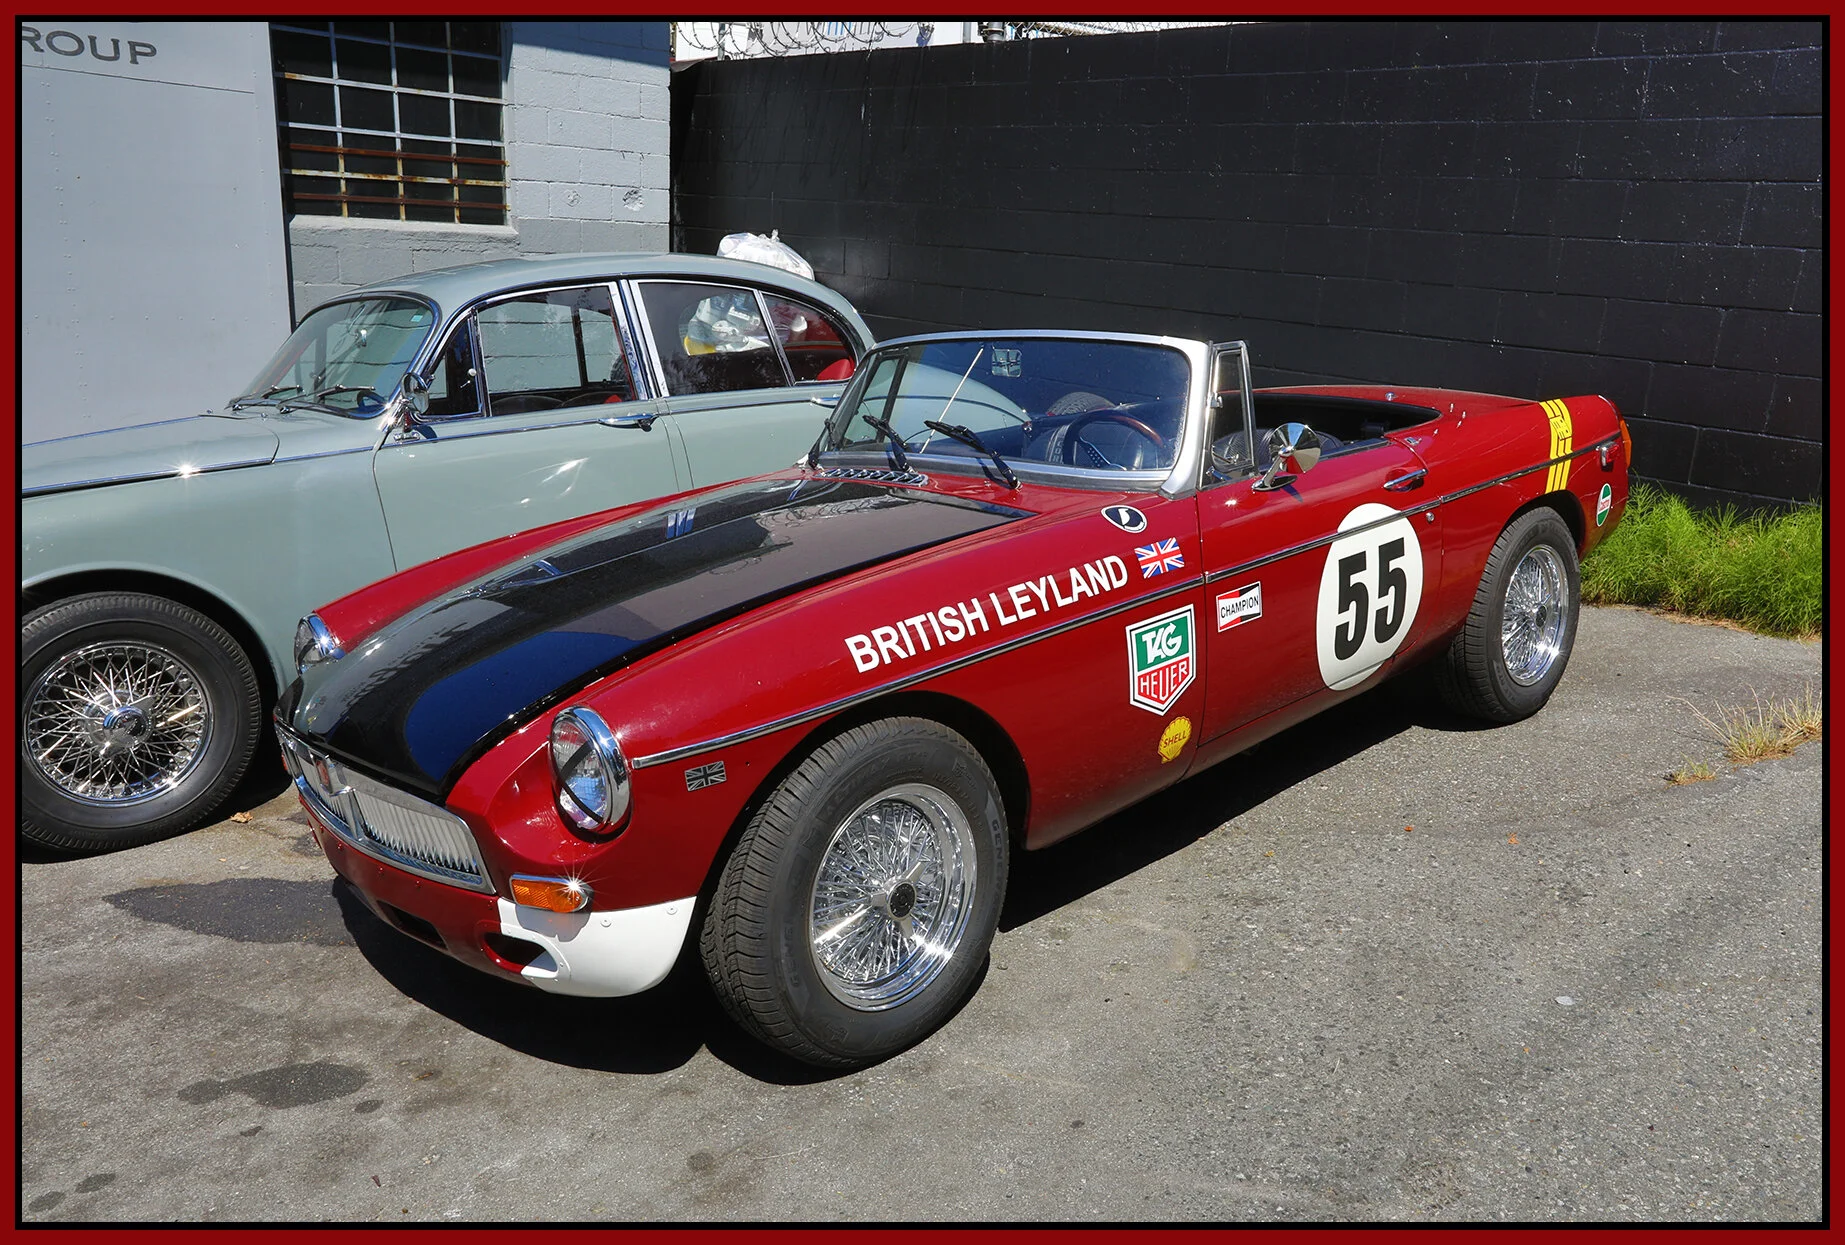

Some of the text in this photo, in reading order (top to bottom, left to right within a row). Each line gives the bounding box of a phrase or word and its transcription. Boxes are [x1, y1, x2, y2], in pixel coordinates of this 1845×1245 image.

[22, 26, 157, 65] ROUP
[844, 555, 1129, 673] BRITISH LEYLAND
[1220, 595, 1259, 619] CHAMPION
[1334, 537, 1407, 661] 55
[1141, 622, 1183, 665] TAG
[1140, 660, 1188, 702] HEUER
[1163, 730, 1187, 749] SHELL
